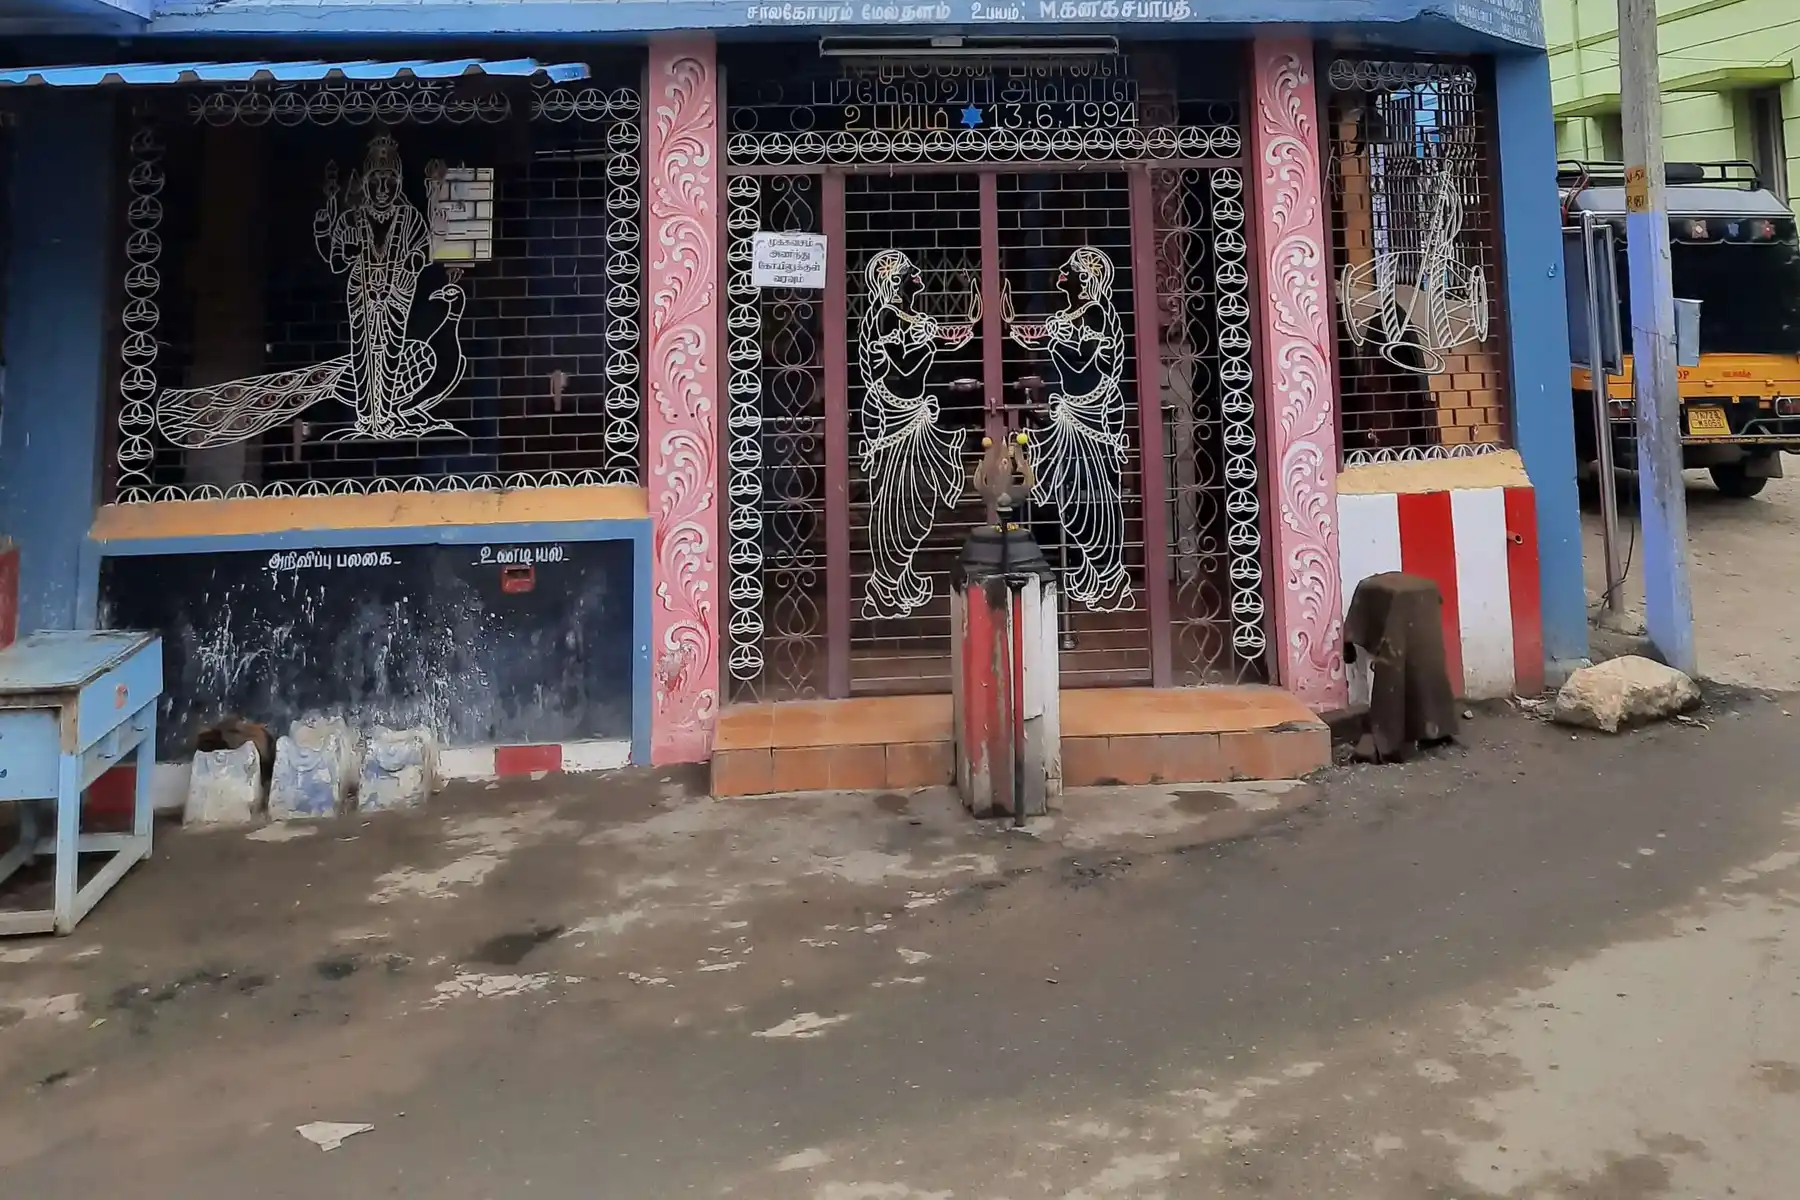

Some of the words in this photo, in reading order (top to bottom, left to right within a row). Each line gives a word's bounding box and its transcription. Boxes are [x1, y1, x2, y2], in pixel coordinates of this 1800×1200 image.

[989, 102, 1140, 129] 13.6.1994
[268, 551, 332, 571] அறிவிப்பு
[337, 551, 393, 568] பலகை
